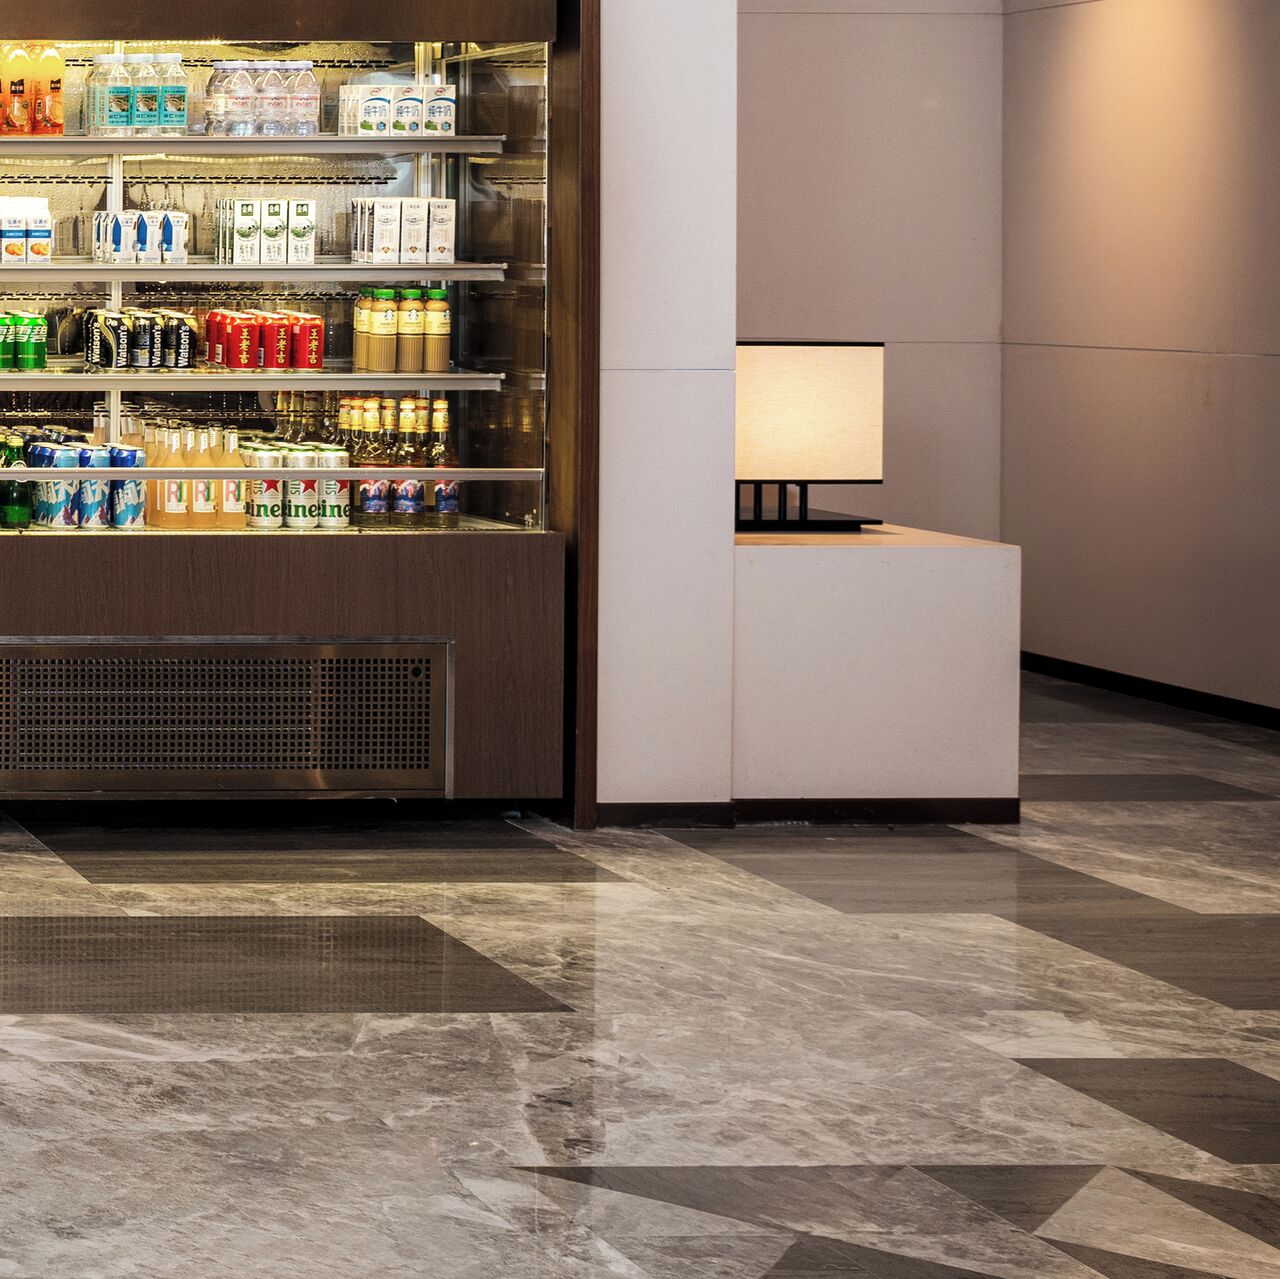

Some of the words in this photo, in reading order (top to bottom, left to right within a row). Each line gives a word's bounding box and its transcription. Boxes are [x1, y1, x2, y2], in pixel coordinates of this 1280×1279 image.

[92, 322, 101, 363] Watson's
[117, 325, 127, 367] Watson's
[151, 325, 161, 367] Watson's
[178, 325, 190, 367] Watson's
[239, 327, 251, 364] 王老吉
[276, 327, 287, 364] 王老吉
[308, 327, 319, 364] 王老吉
